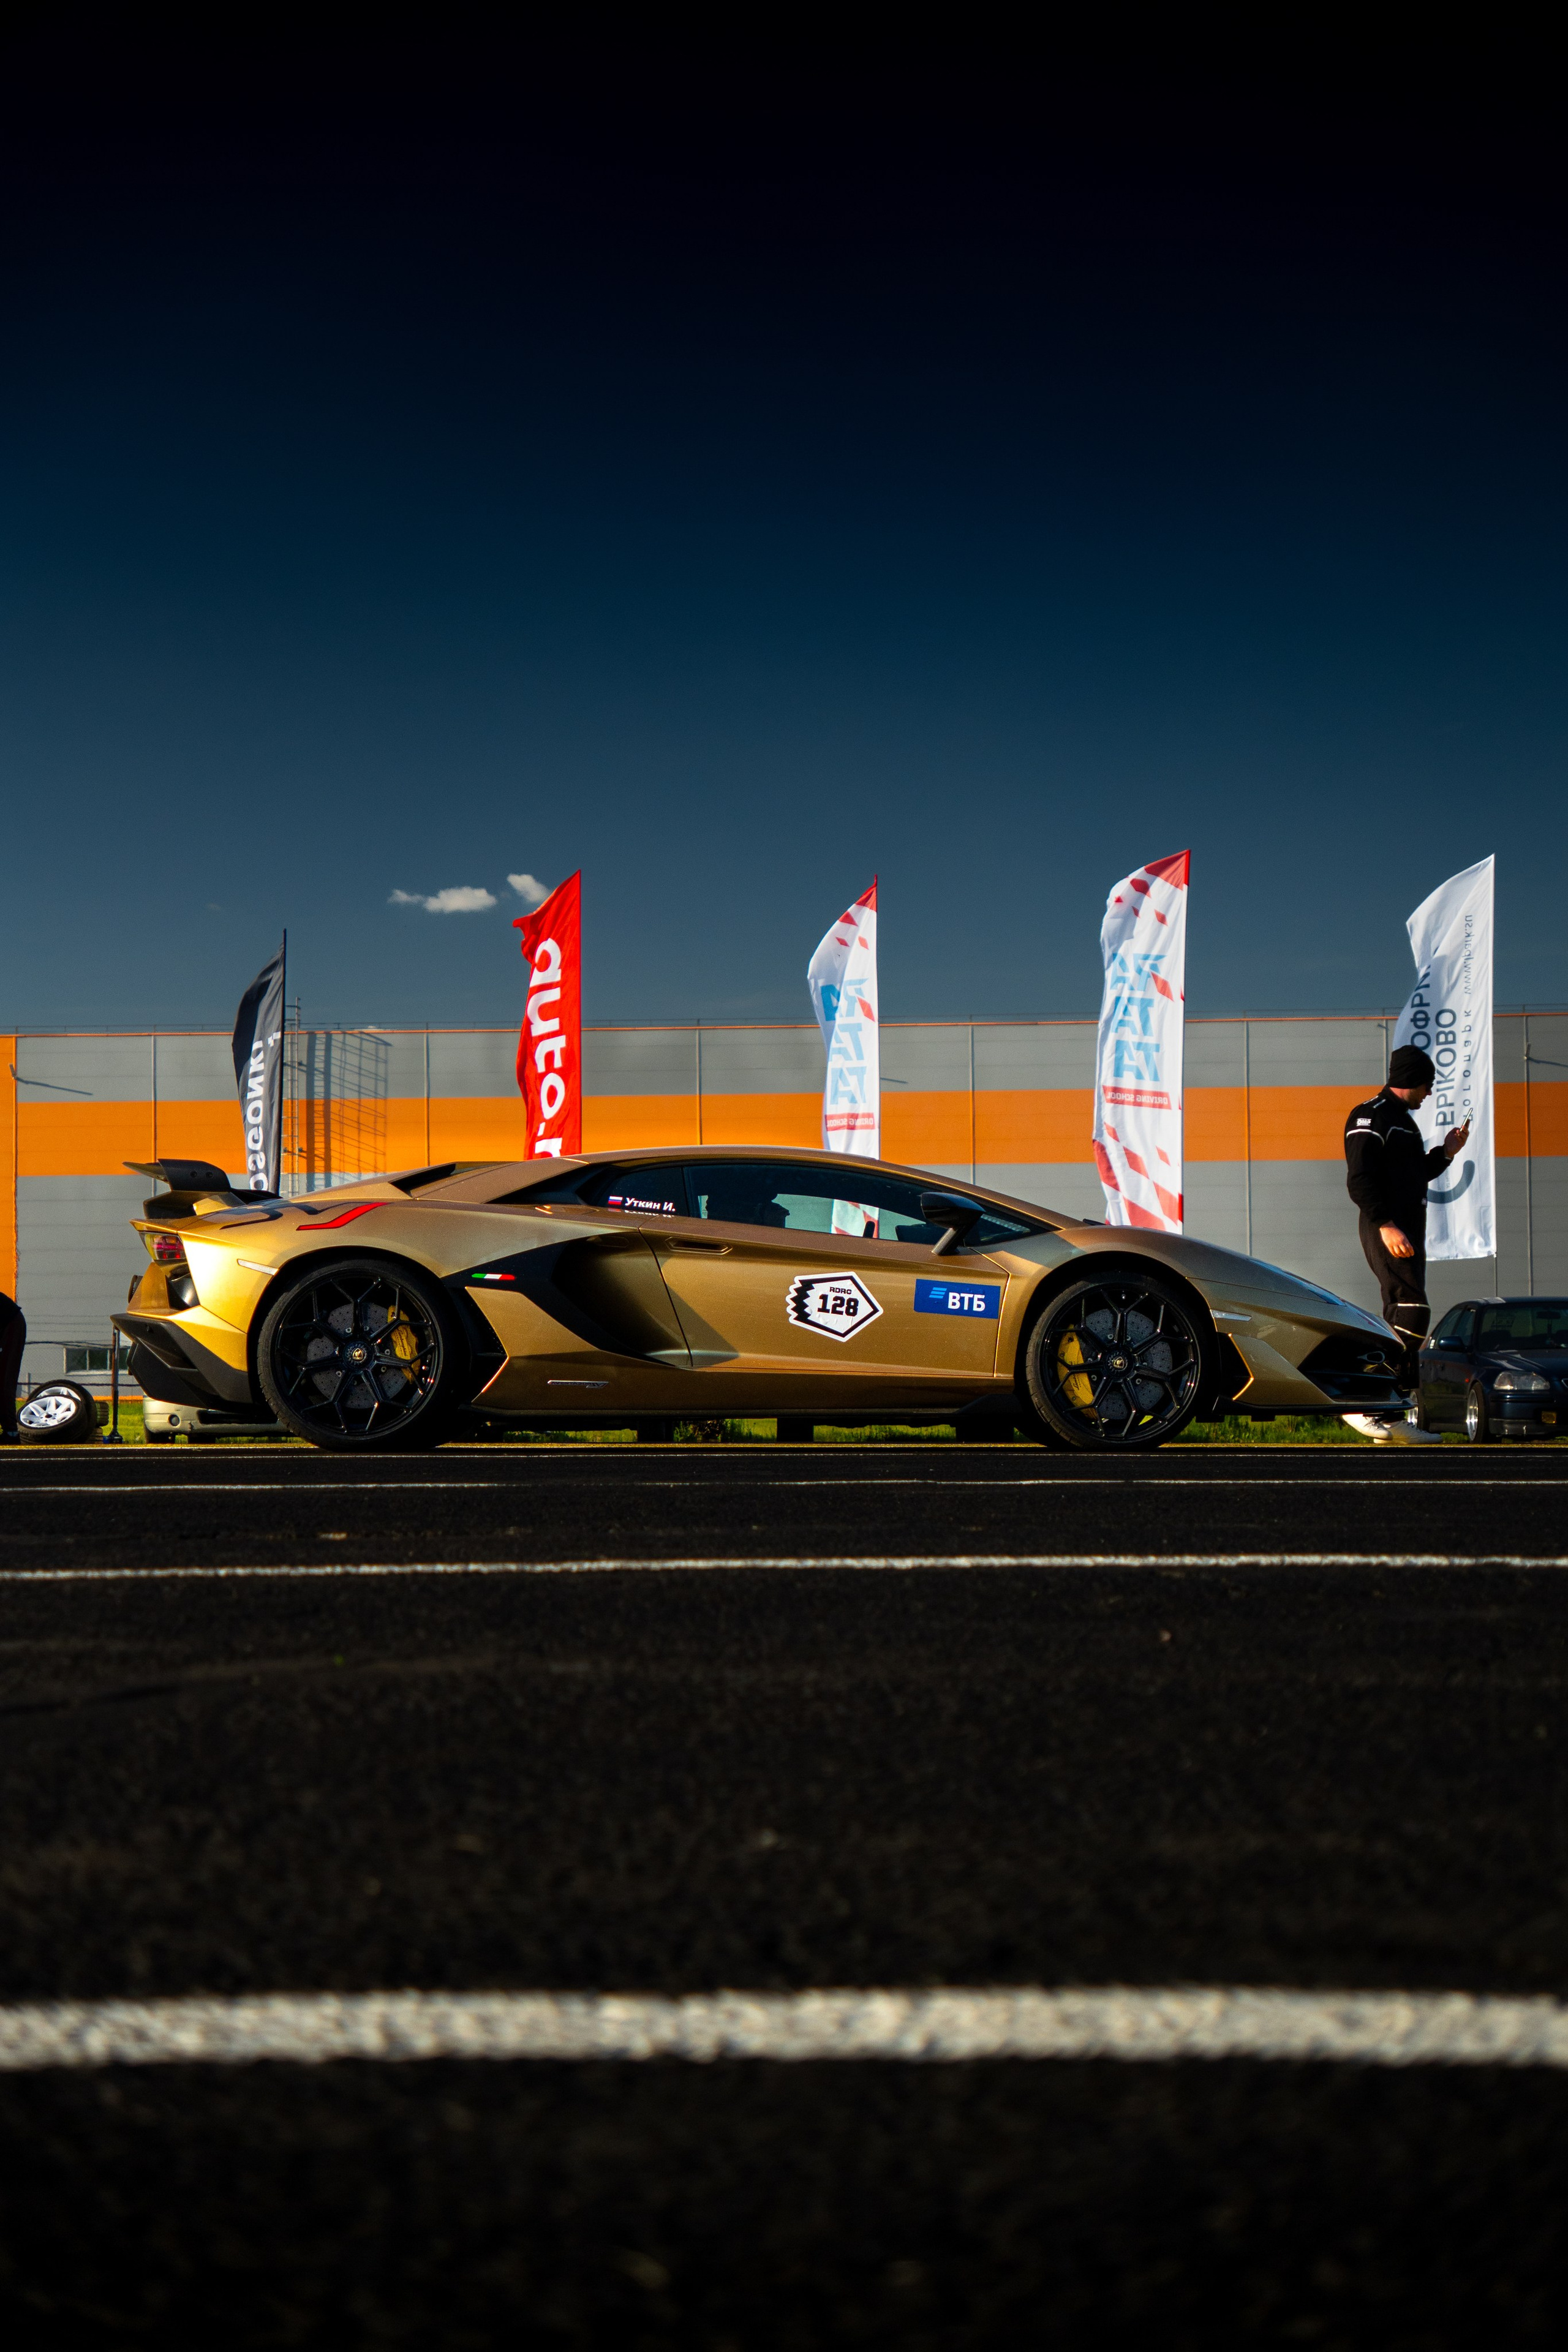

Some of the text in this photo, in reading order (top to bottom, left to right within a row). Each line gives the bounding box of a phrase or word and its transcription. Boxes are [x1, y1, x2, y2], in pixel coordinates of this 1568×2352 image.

[526, 937, 567, 1158] auto.r
[625, 1197, 676, 1212] Уткин И.
[829, 1286, 853, 1295] RDRC
[817, 1294, 859, 1317] 128
[948, 1292, 986, 1312] ВТБ
